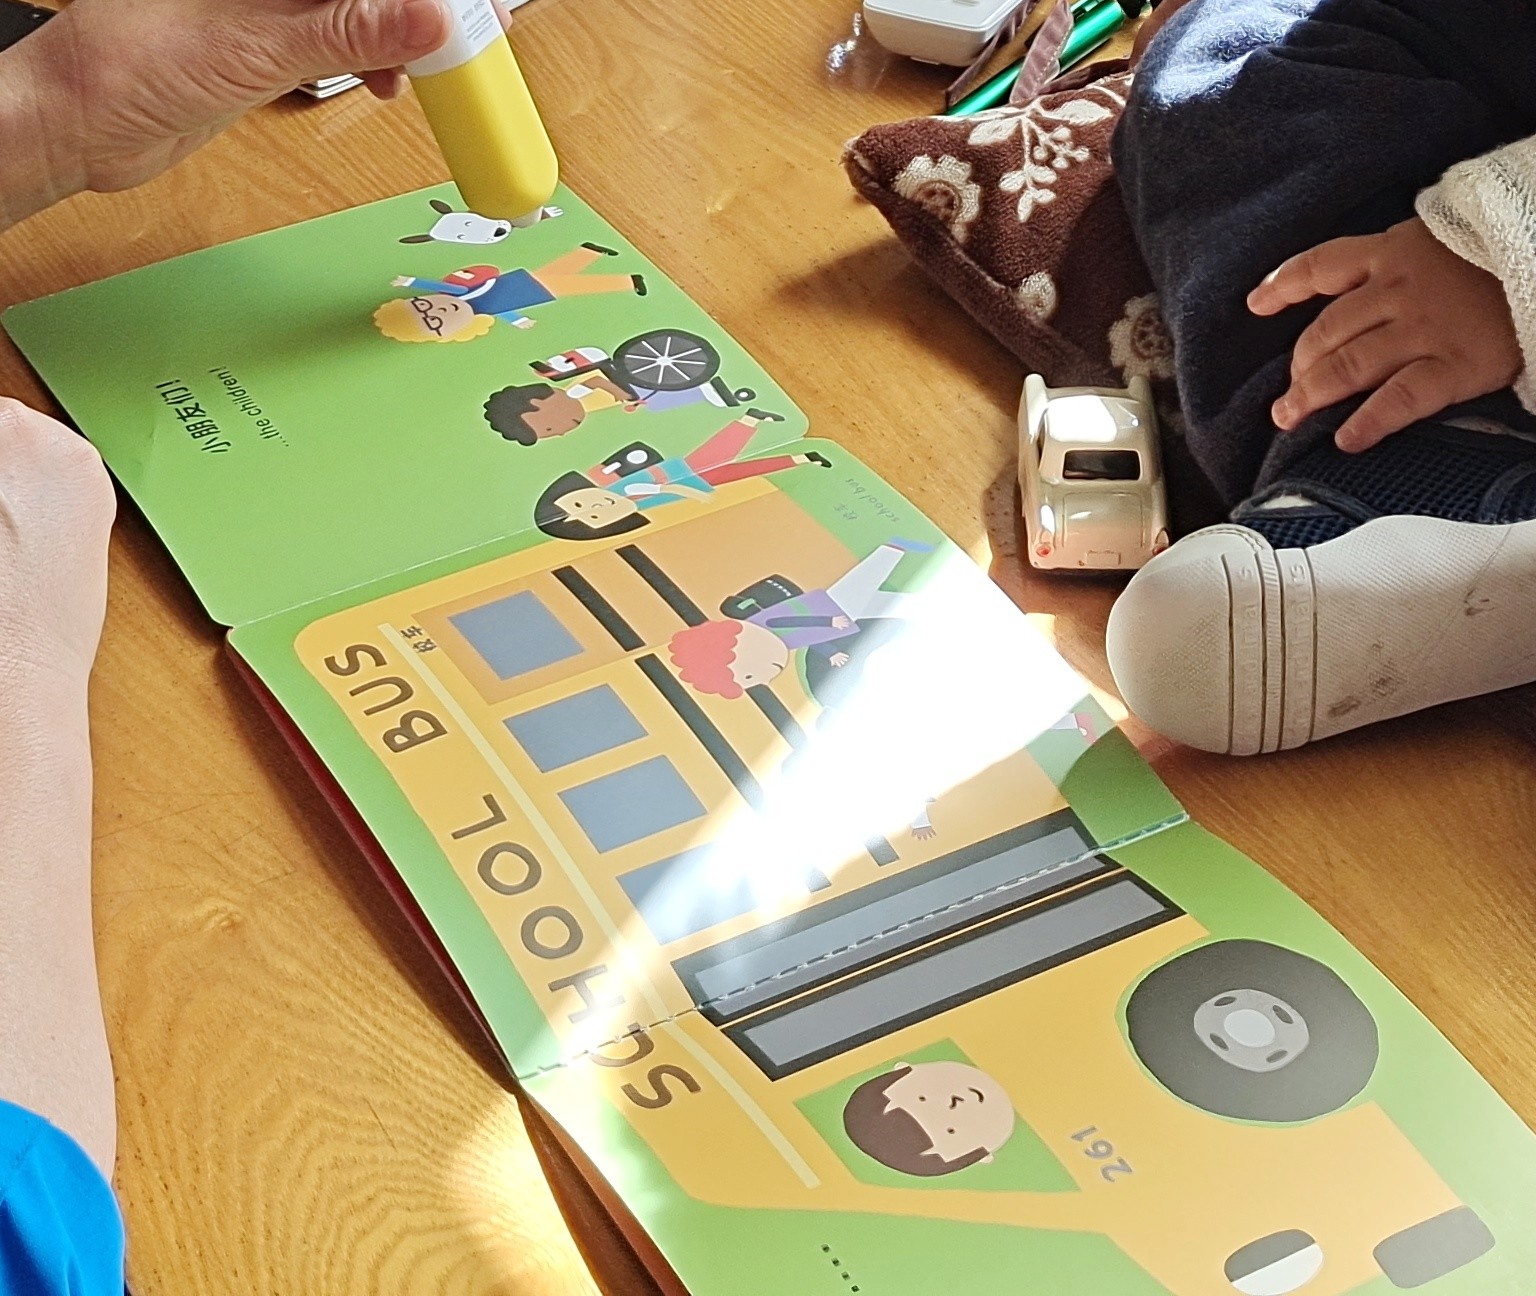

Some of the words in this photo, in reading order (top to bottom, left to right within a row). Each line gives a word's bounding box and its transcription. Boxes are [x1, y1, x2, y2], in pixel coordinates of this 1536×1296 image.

[155, 379, 232, 453] 小朋友们！
[208, 366, 262, 416] children!
[324, 644, 448, 753] BUS
[451, 793, 701, 1109] SCHOOL
[1070, 1125, 1133, 1183] 261
